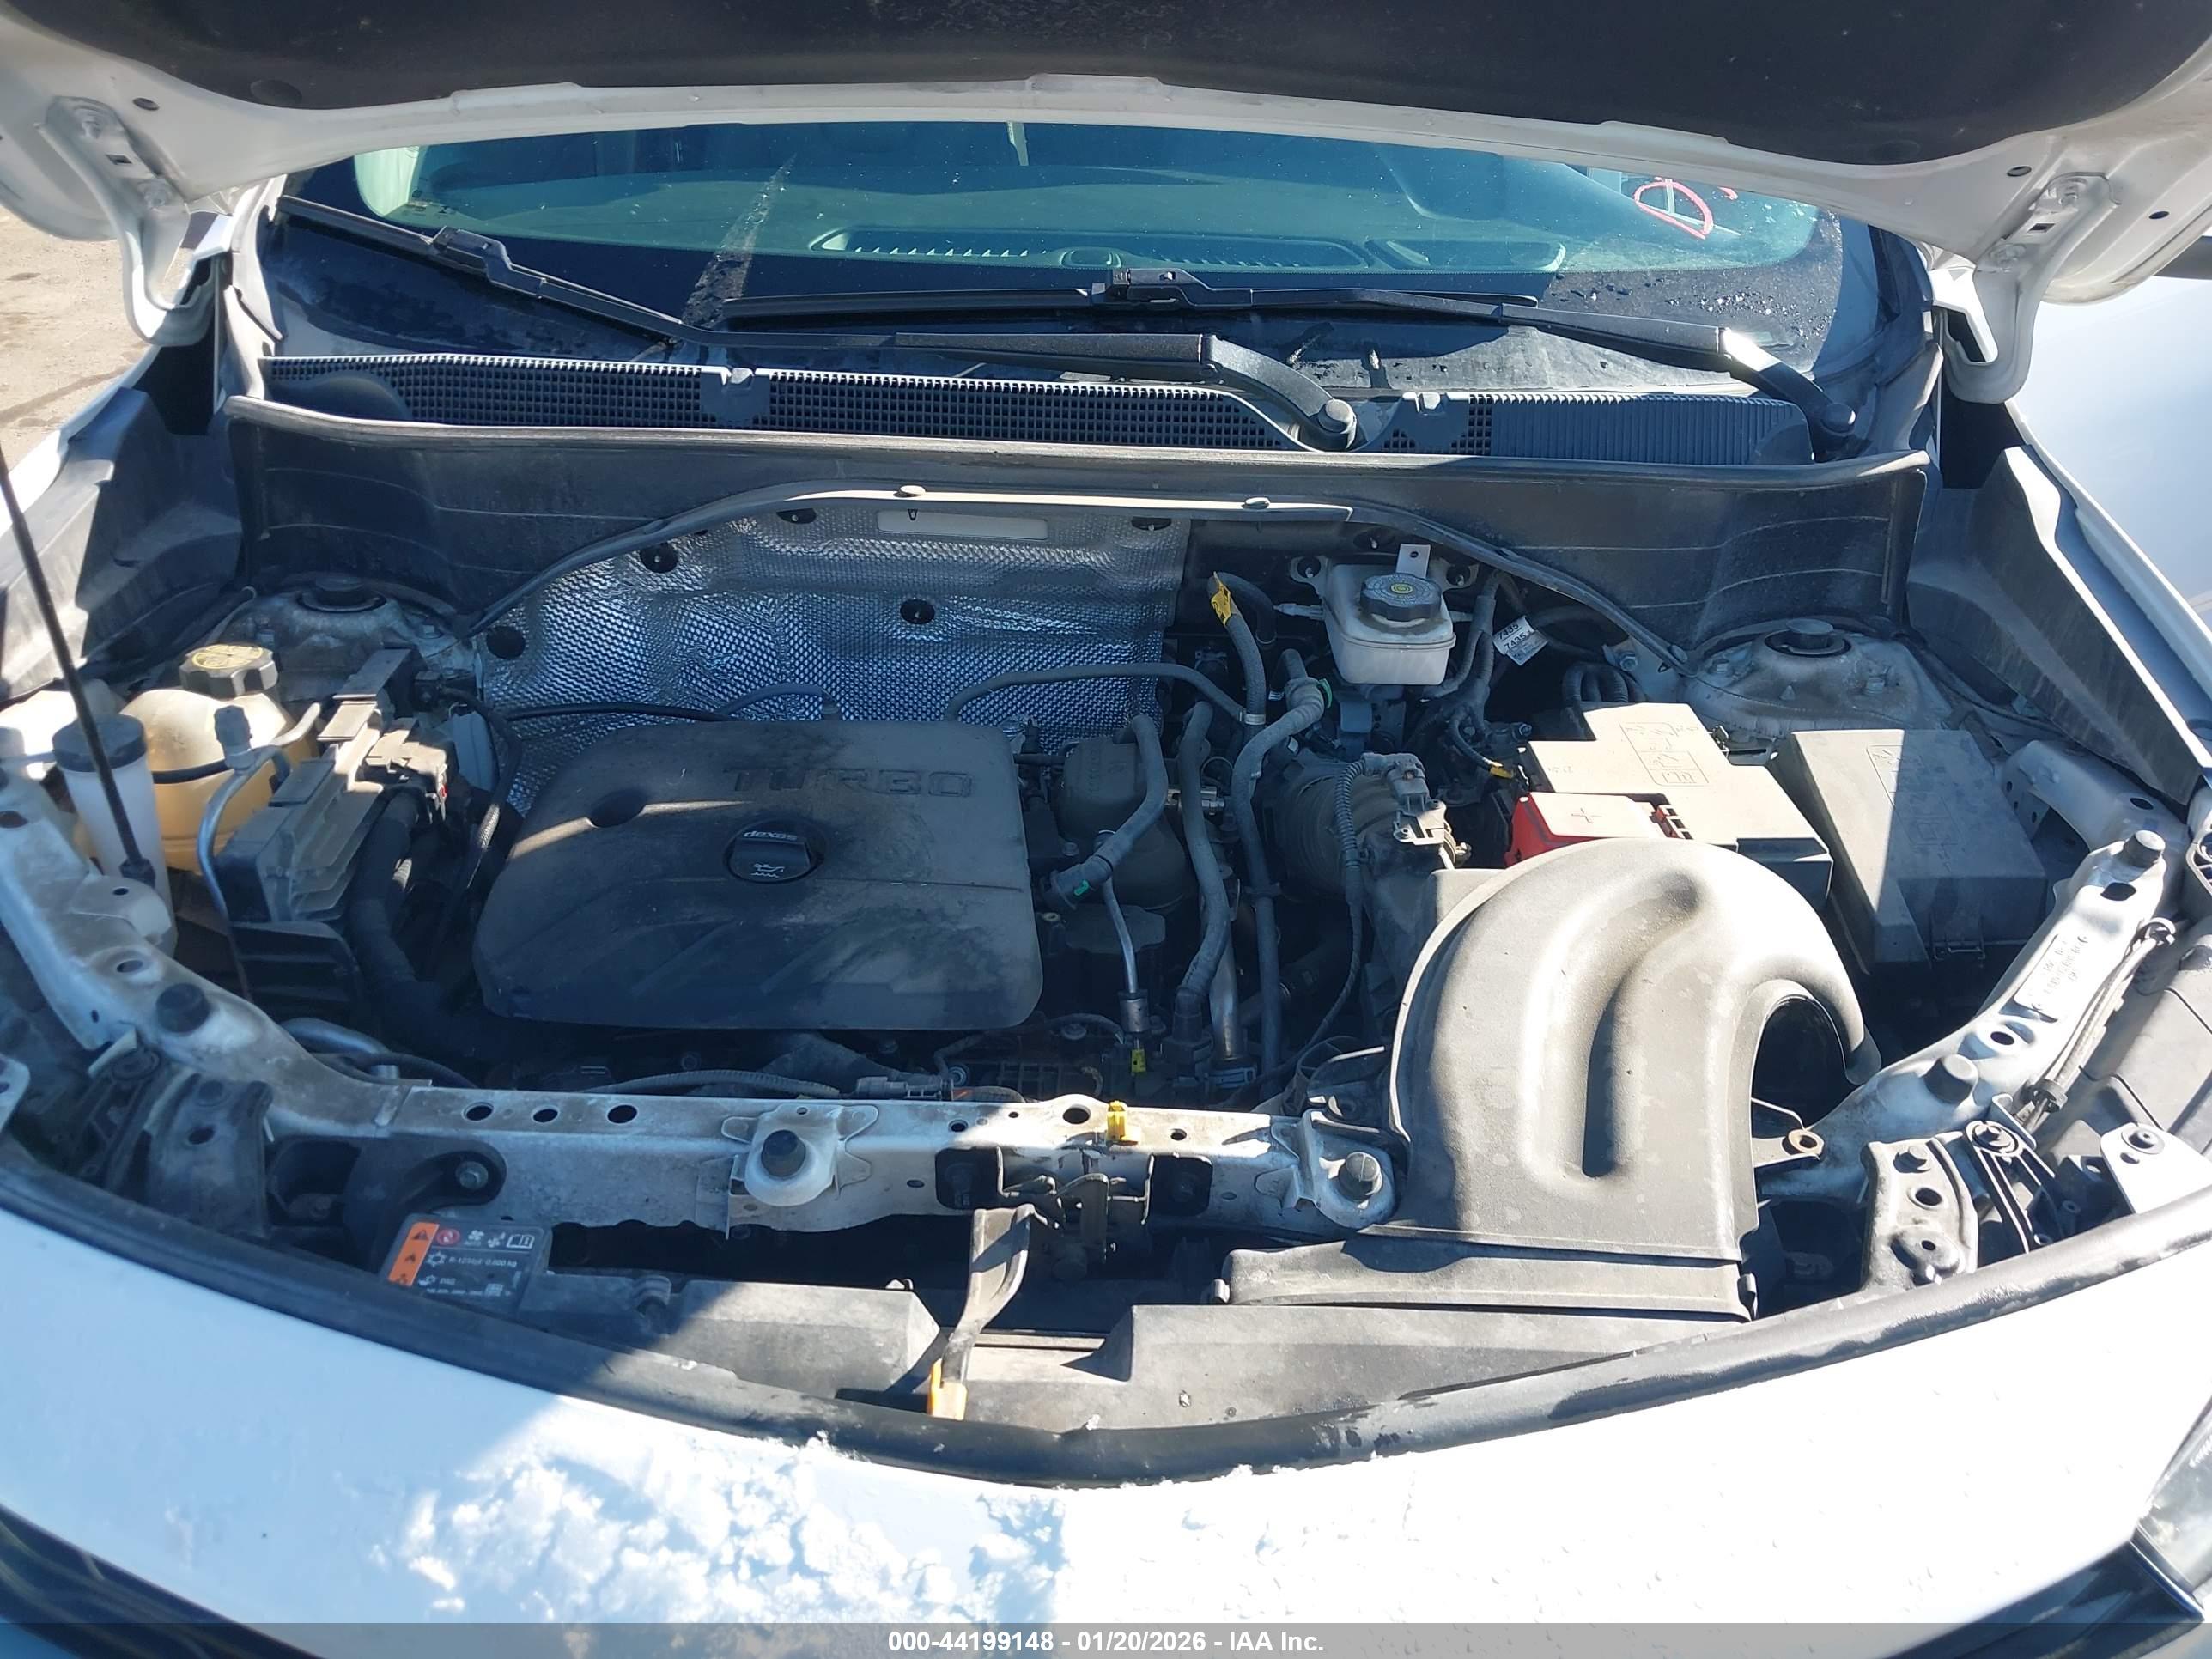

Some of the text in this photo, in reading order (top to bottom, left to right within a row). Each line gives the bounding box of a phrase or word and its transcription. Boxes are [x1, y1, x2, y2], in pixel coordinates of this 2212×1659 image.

[1498, 623, 1519, 640] 7435
[1504, 632, 1527, 650] 7435
[723, 767, 974, 799] TURBO
[744, 830, 799, 842] dexos
